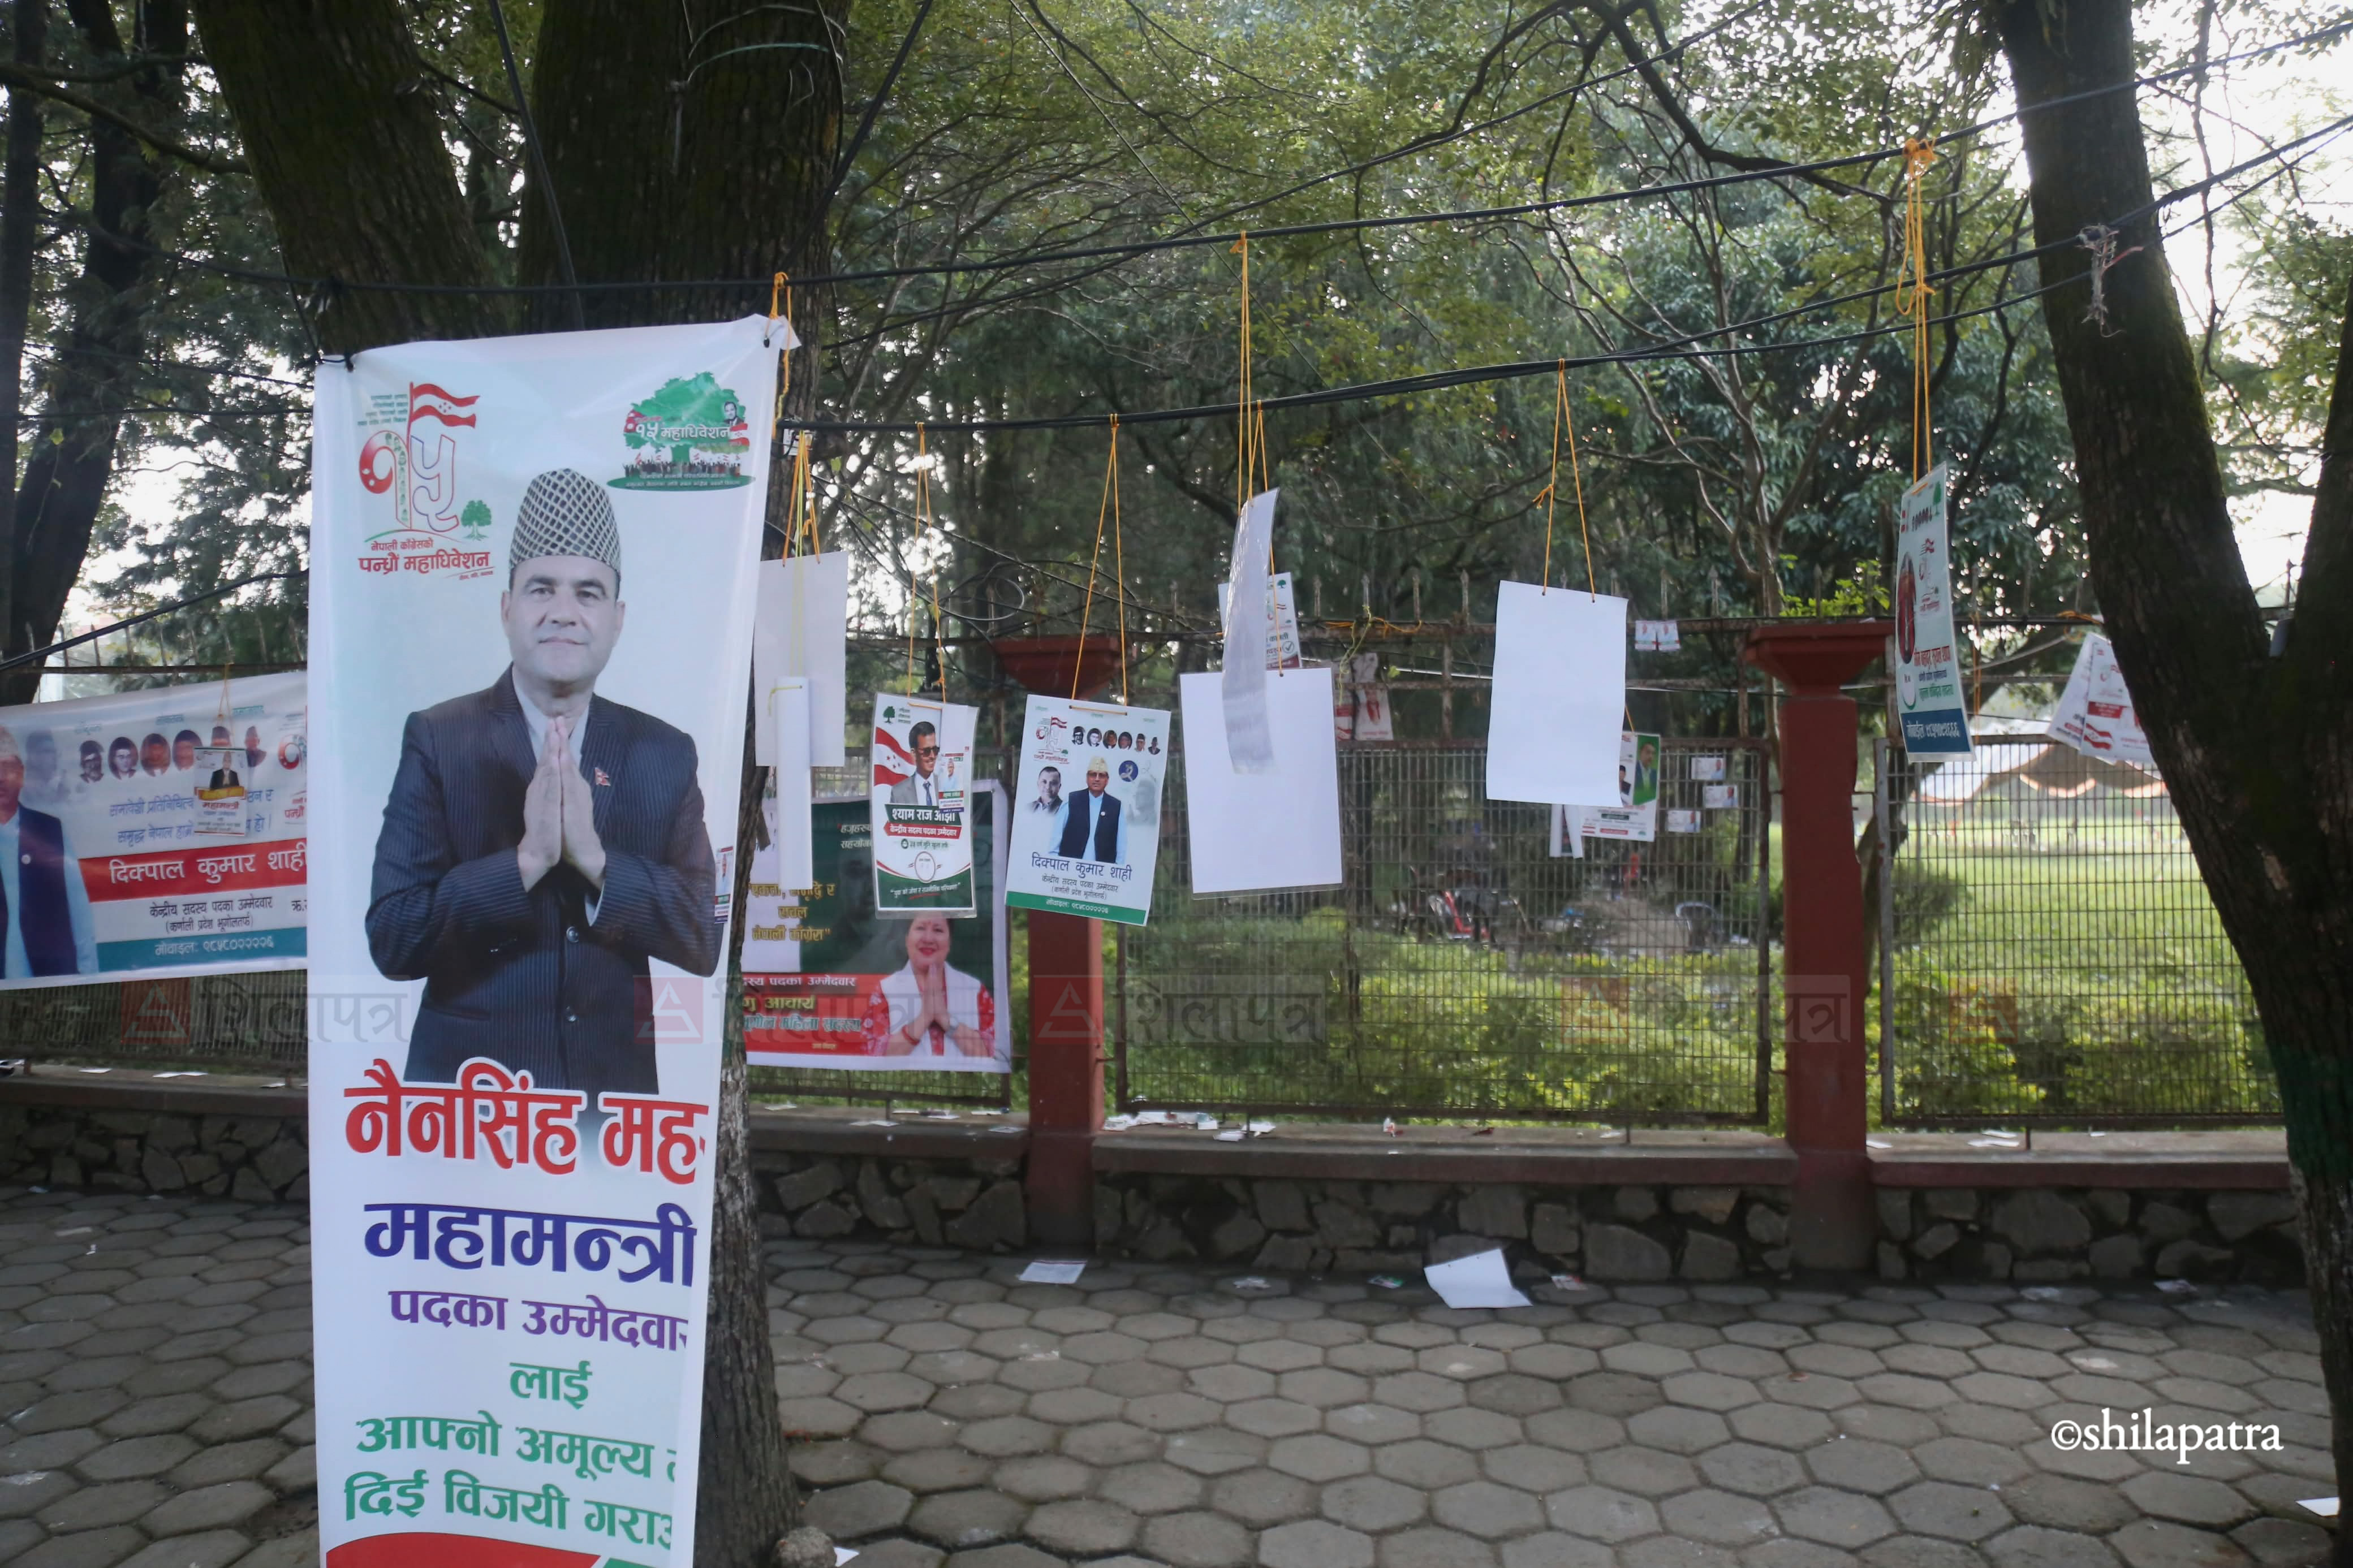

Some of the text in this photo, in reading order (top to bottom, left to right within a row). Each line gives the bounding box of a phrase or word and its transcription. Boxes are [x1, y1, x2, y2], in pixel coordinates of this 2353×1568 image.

[661, 424, 731, 441] महाधिवेशन
[371, 539, 398, 551] नेपाली
[403, 548, 490, 574] महाधिवेशन
[891, 808, 915, 820] श्याम
[916, 809, 933, 821] राज
[148, 823, 174, 839] नेपाल
[109, 841, 307, 884] दिक्पाल कुमार शाही
[1031, 852, 1132, 882] दिक्पाल कुमार शाही
[149, 901, 178, 918] केन्द्रीय
[183, 902, 207, 915] सदस्य
[212, 900, 234, 912] पदका
[238, 893, 273, 910] उम्मेदवार
[769, 977, 802, 987] पदका
[808, 975, 857, 987] उम्मेदवार
[764, 995, 816, 1010] आचार्य
[343, 1058, 709, 1185] नैनसिंह मह
[364, 1202, 697, 1287] महामन्त्री
[388, 1290, 508, 1331] पदका
[509, 1360, 593, 1410] लाई
[355, 1410, 502, 1457] आफ्नो
[515, 1426, 654, 1481] अमूल्य
[344, 1469, 429, 1521] दिई
[444, 1468, 570, 1530] विजयी
